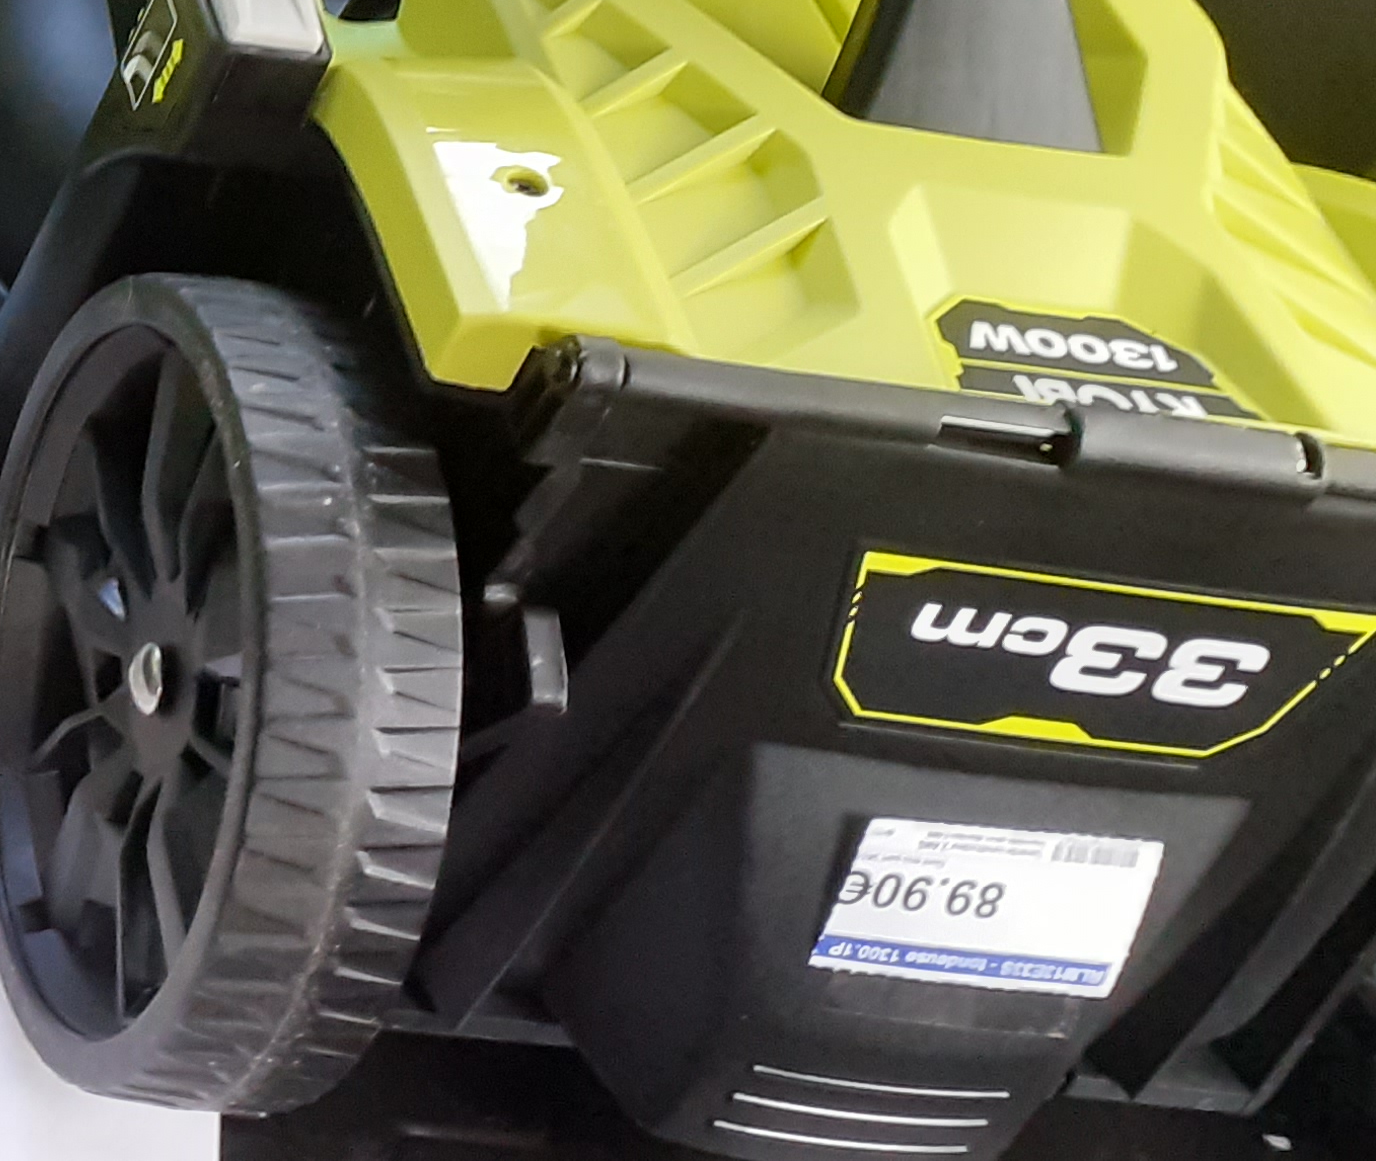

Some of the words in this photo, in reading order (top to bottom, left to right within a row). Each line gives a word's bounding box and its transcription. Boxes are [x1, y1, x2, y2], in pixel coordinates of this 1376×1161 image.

[970, 320, 1179, 372] 1300W
[911, 602, 1269, 707] 33cm
[839, 872, 1004, 918] 89.90€
